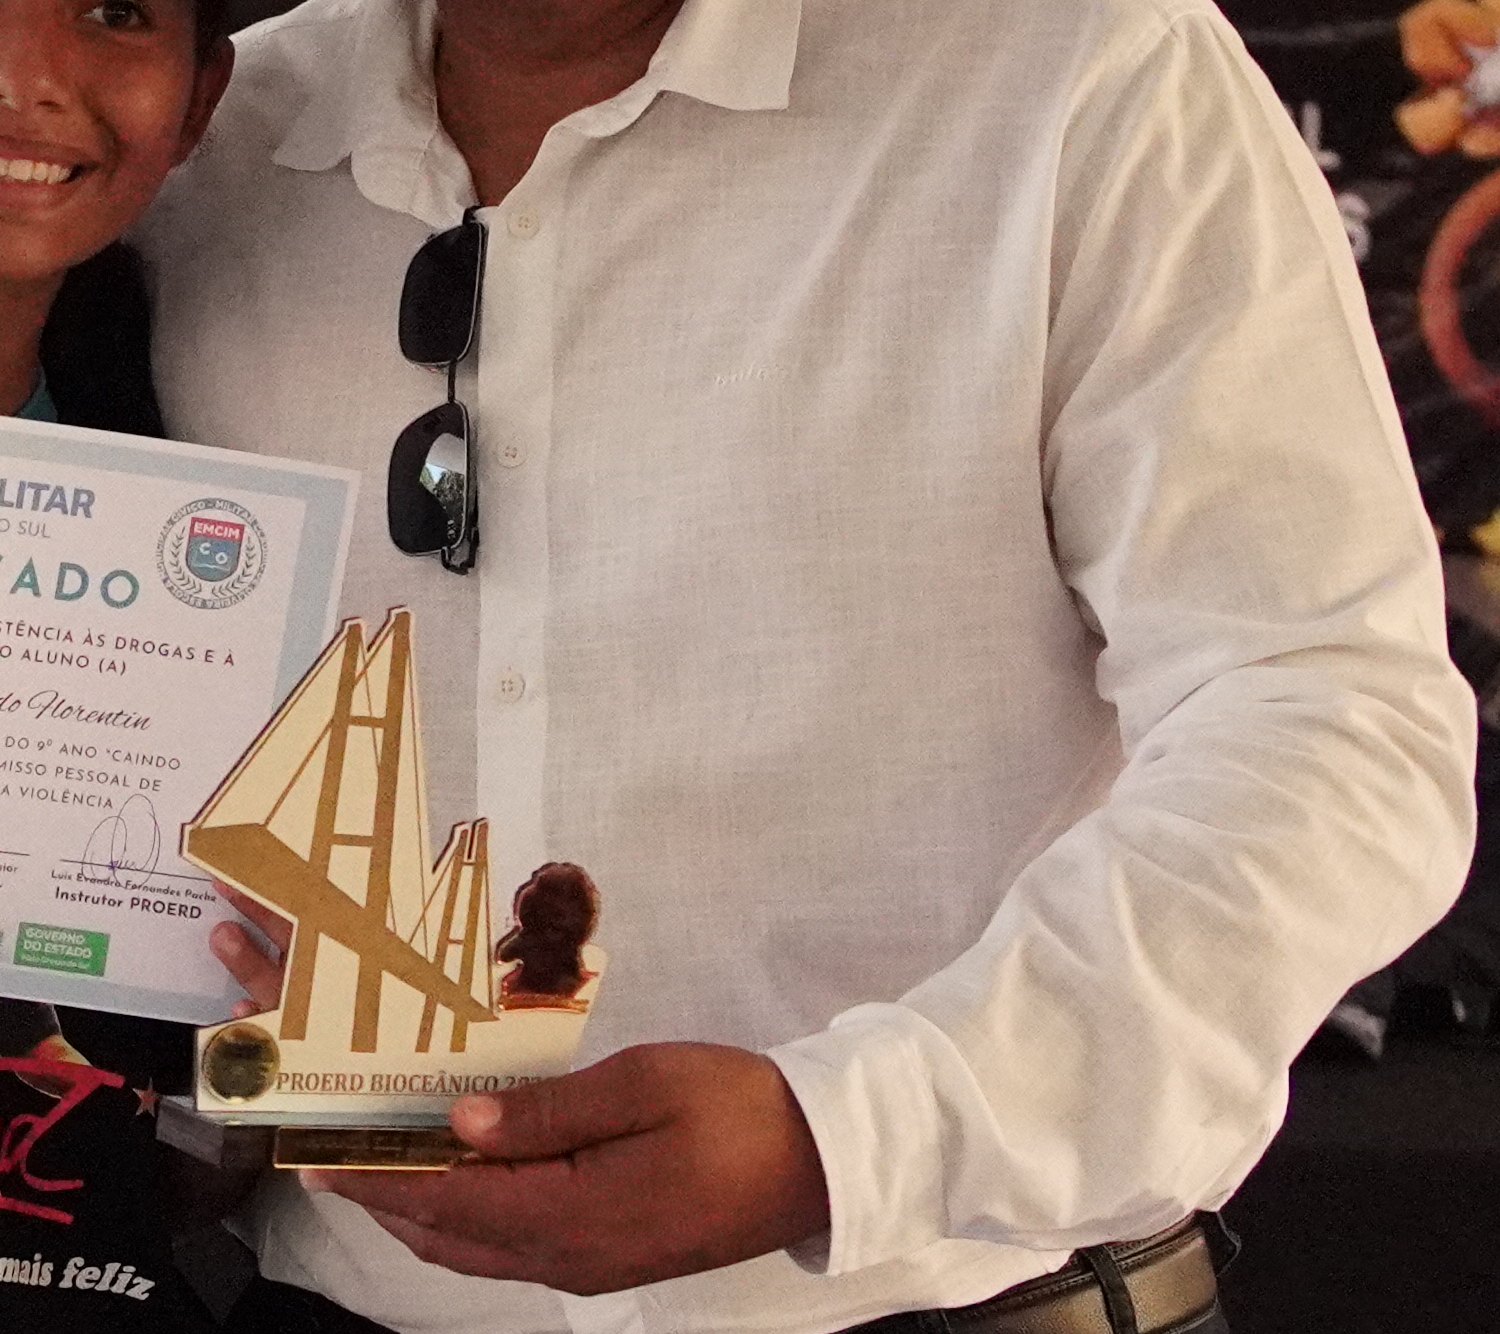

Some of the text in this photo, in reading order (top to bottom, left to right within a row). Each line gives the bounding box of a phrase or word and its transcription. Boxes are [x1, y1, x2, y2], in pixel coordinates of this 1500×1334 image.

[17, 520, 51, 538] SUL
[193, 521, 240, 539] EMCIM
[82, 628, 105, 647] ÀS
[115, 636, 195, 660] DROGAS
[204, 650, 215, 664] E
[223, 648, 235, 666] À
[0, 645, 12, 658] O
[21, 648, 89, 668] ALUNO
[98, 658, 127, 676] (A)
[26, 689, 152, 731] Florentin
[5, 735, 29, 750] DO
[59, 743, 97, 759] ANO
[55, 766, 130, 789] PESSOAL
[138, 778, 162, 792] DE
[19, 785, 114, 809] VIOLÊNCIA
[76, 873, 122, 888] Evandro
[124, 879, 181, 898] Fernandes
[55, 886, 202, 920] Instrutor PROERD
[25, 927, 85, 945] GOVERNO
[23, 939, 92, 959] DO ESTADO
[275, 1071, 363, 1092] PROERD
[371, 1069, 499, 1094] BIOCEÂNICO
[58, 1256, 156, 1301] feliz
